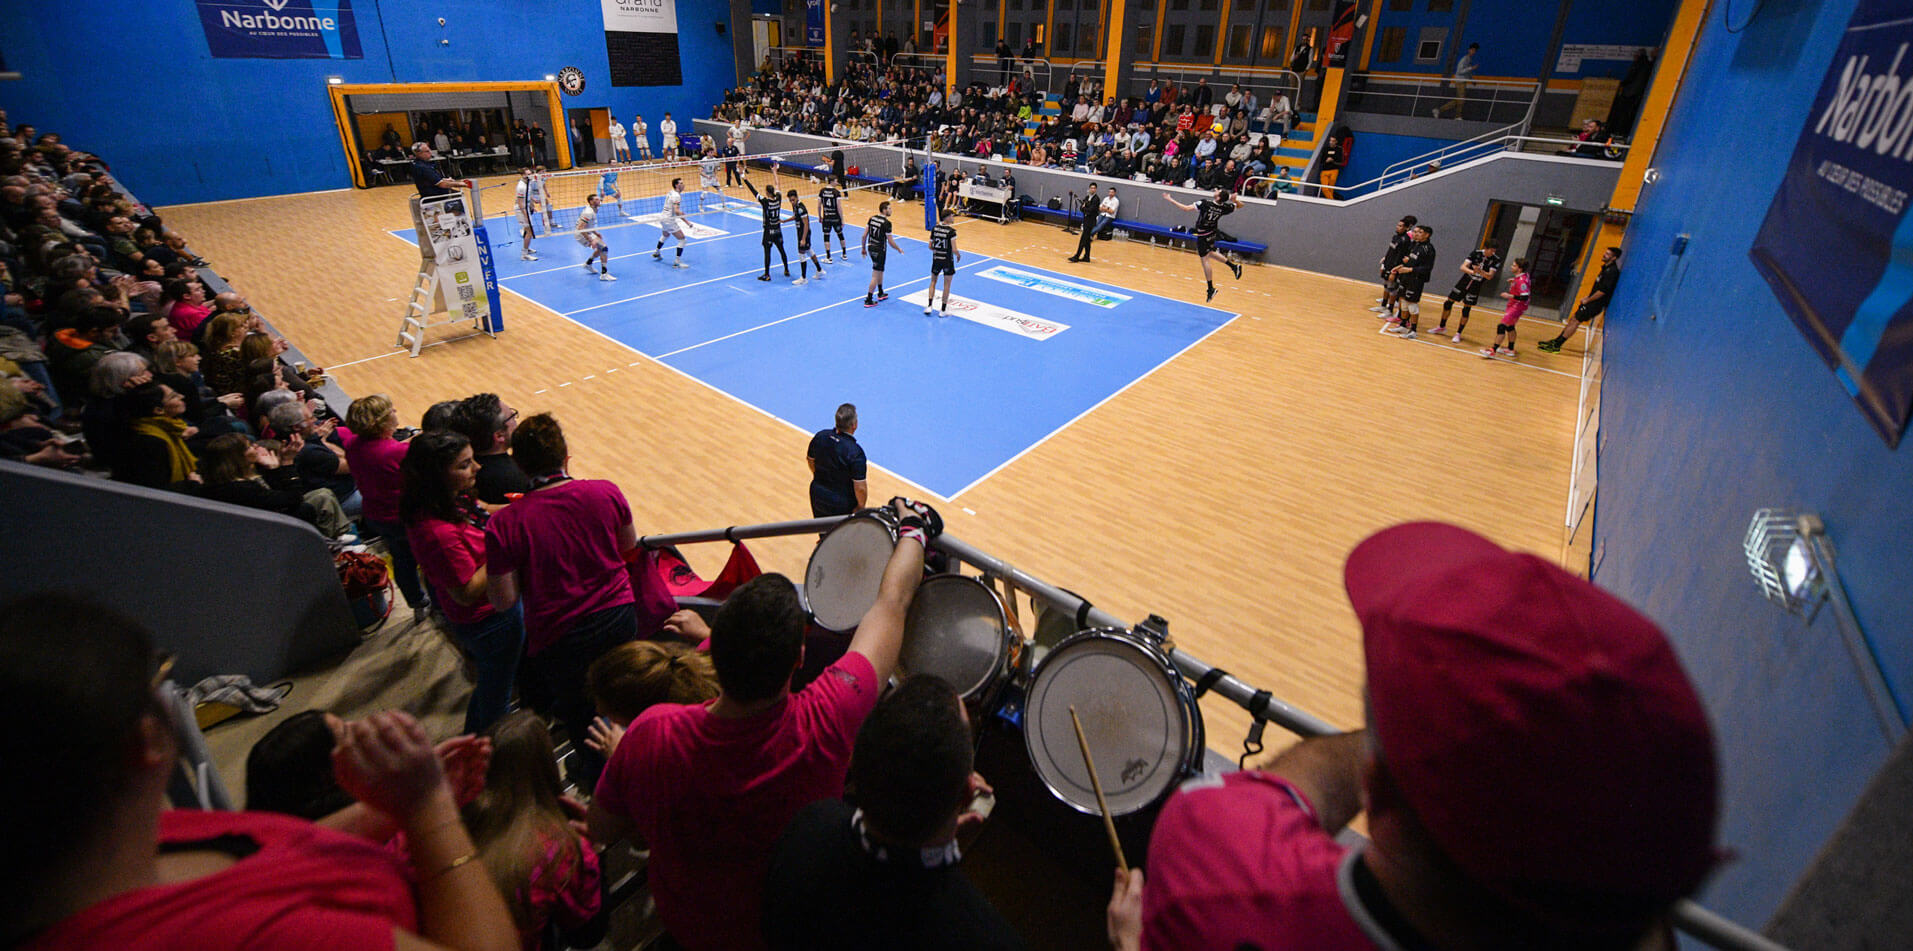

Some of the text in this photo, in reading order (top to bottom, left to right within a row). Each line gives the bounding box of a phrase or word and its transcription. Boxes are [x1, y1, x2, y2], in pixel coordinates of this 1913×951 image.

[220, 10, 335, 30] Narbonne
[826, 198, 832, 207] 4
[872, 226, 878, 237] 7
[934, 238, 946, 249] 21
